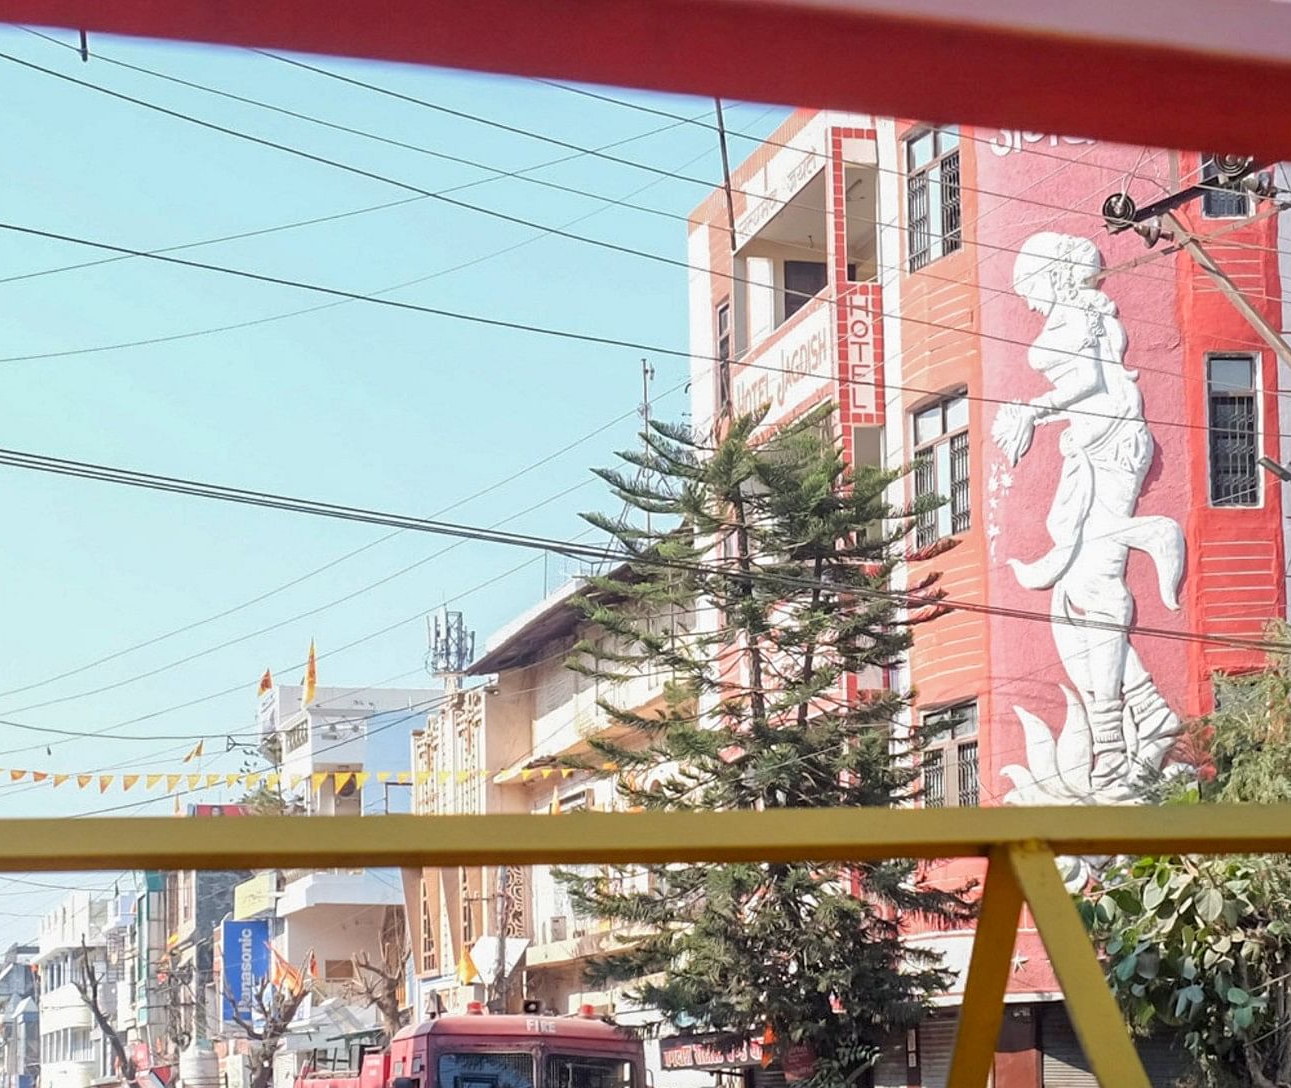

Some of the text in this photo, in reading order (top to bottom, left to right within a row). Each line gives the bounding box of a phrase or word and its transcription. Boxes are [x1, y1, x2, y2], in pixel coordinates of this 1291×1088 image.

[777, 327, 827, 407] JAGDISH
[848, 296, 871, 410] HOTEL
[525, 1017, 557, 1034] FIRE
